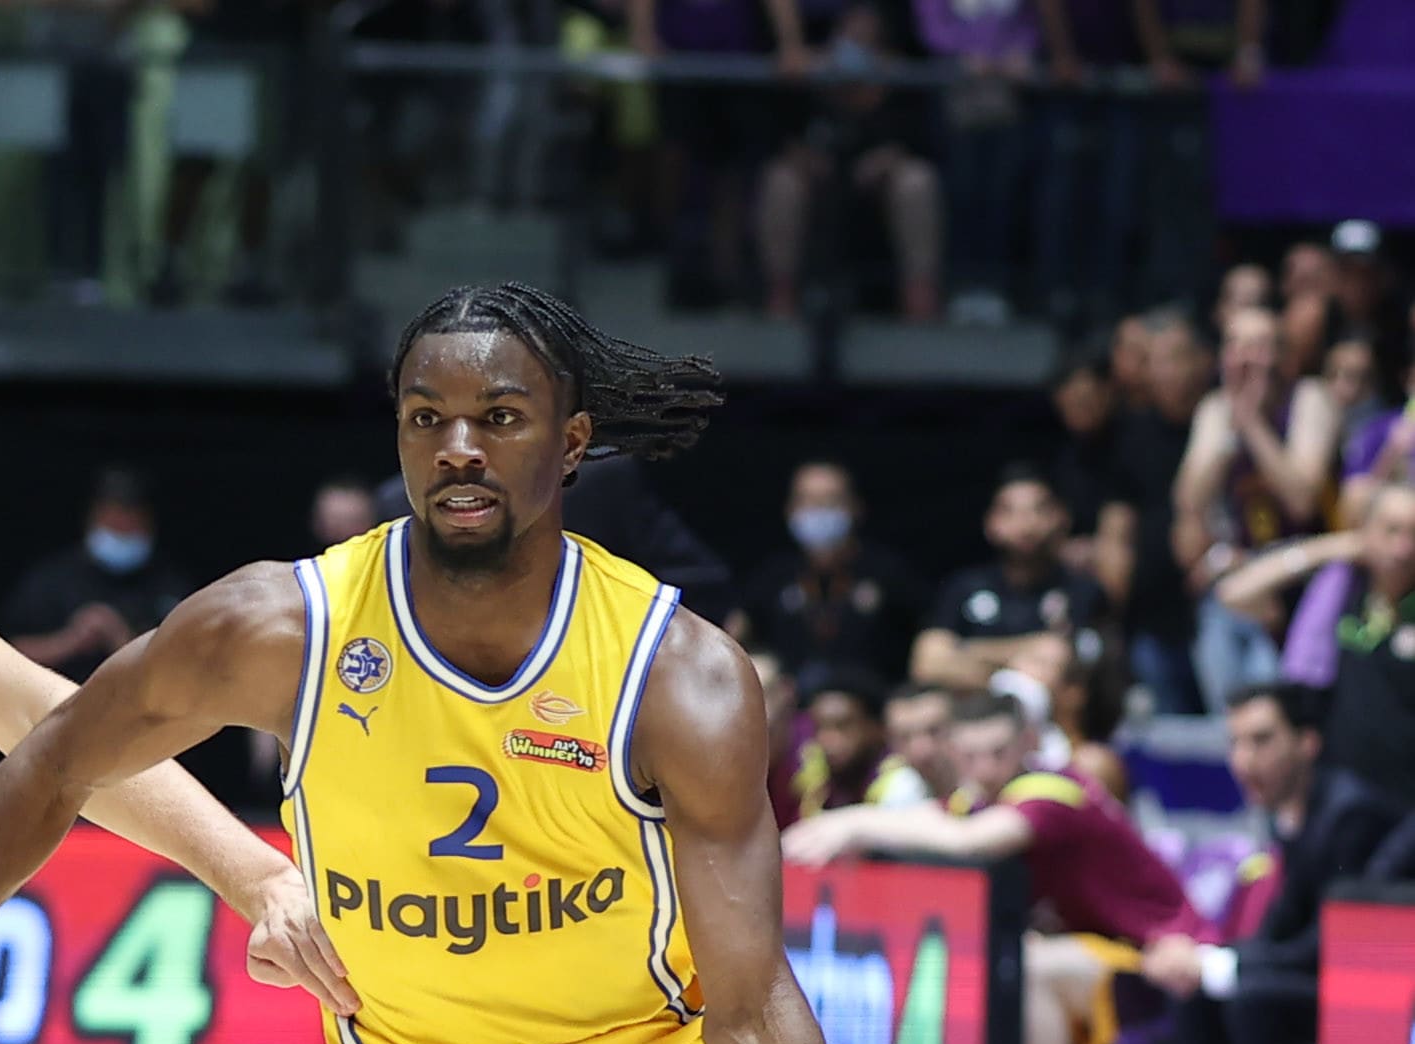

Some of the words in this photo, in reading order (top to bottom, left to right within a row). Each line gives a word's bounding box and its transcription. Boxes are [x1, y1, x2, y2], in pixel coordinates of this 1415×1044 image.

[511, 736, 578, 762] Winner
[578, 751, 594, 767] סל
[424, 765, 504, 861] 2
[326, 866, 625, 956] Playtika
